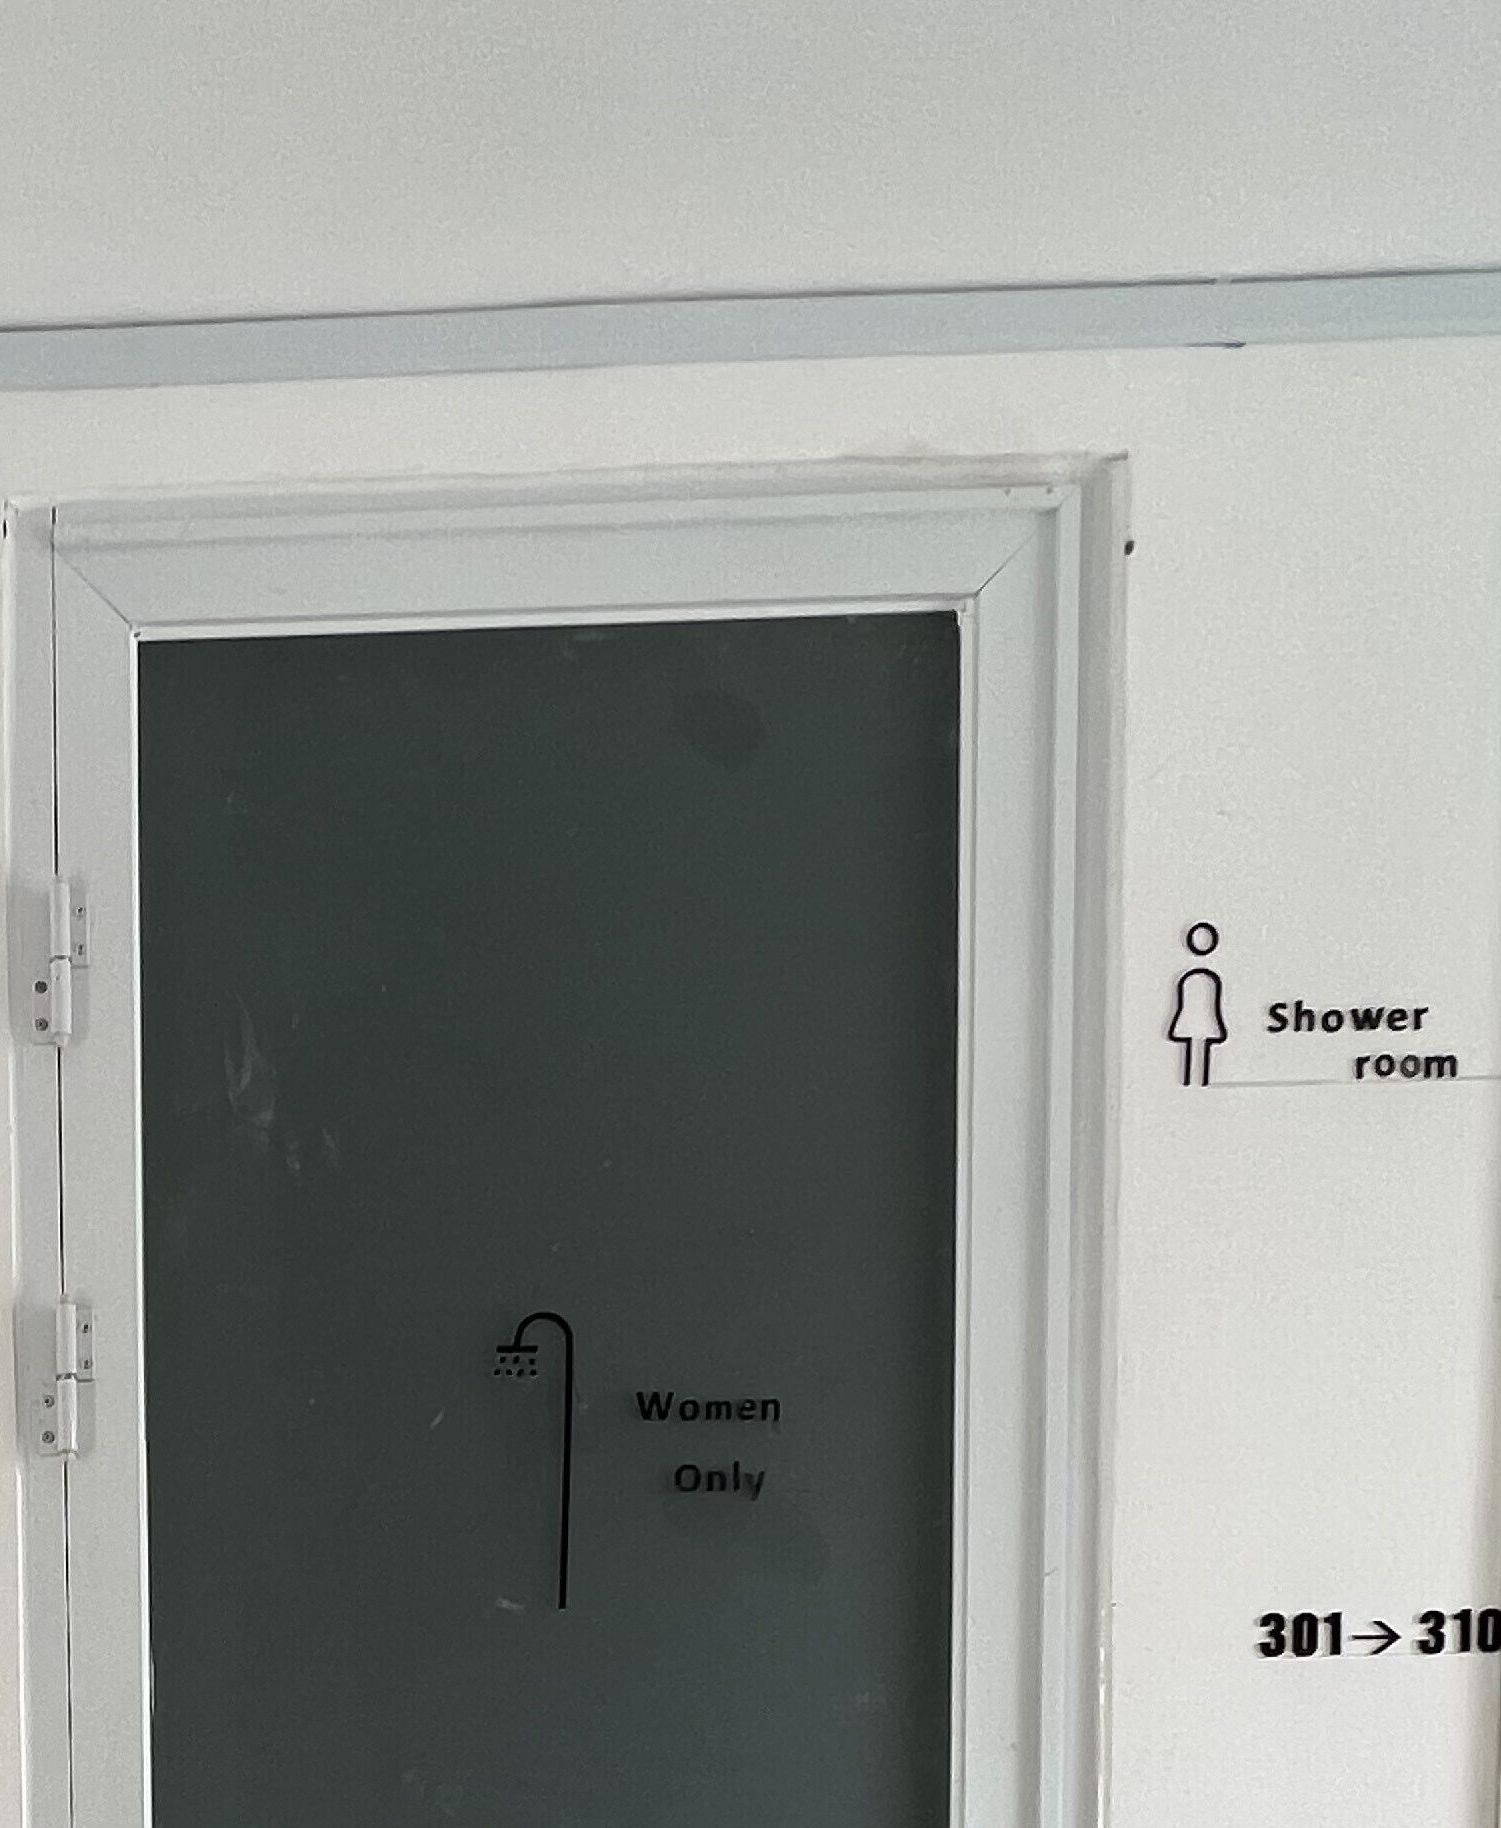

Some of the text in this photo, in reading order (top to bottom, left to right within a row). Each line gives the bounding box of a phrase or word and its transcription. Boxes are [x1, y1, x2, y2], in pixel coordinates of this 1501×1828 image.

[1266, 999, 1429, 1034] Shower
[1354, 1053, 1458, 1080] room
[635, 1390, 781, 1423] Women
[673, 1460, 766, 1502] Only
[1257, 1607, 1501, 1658] 301 310
